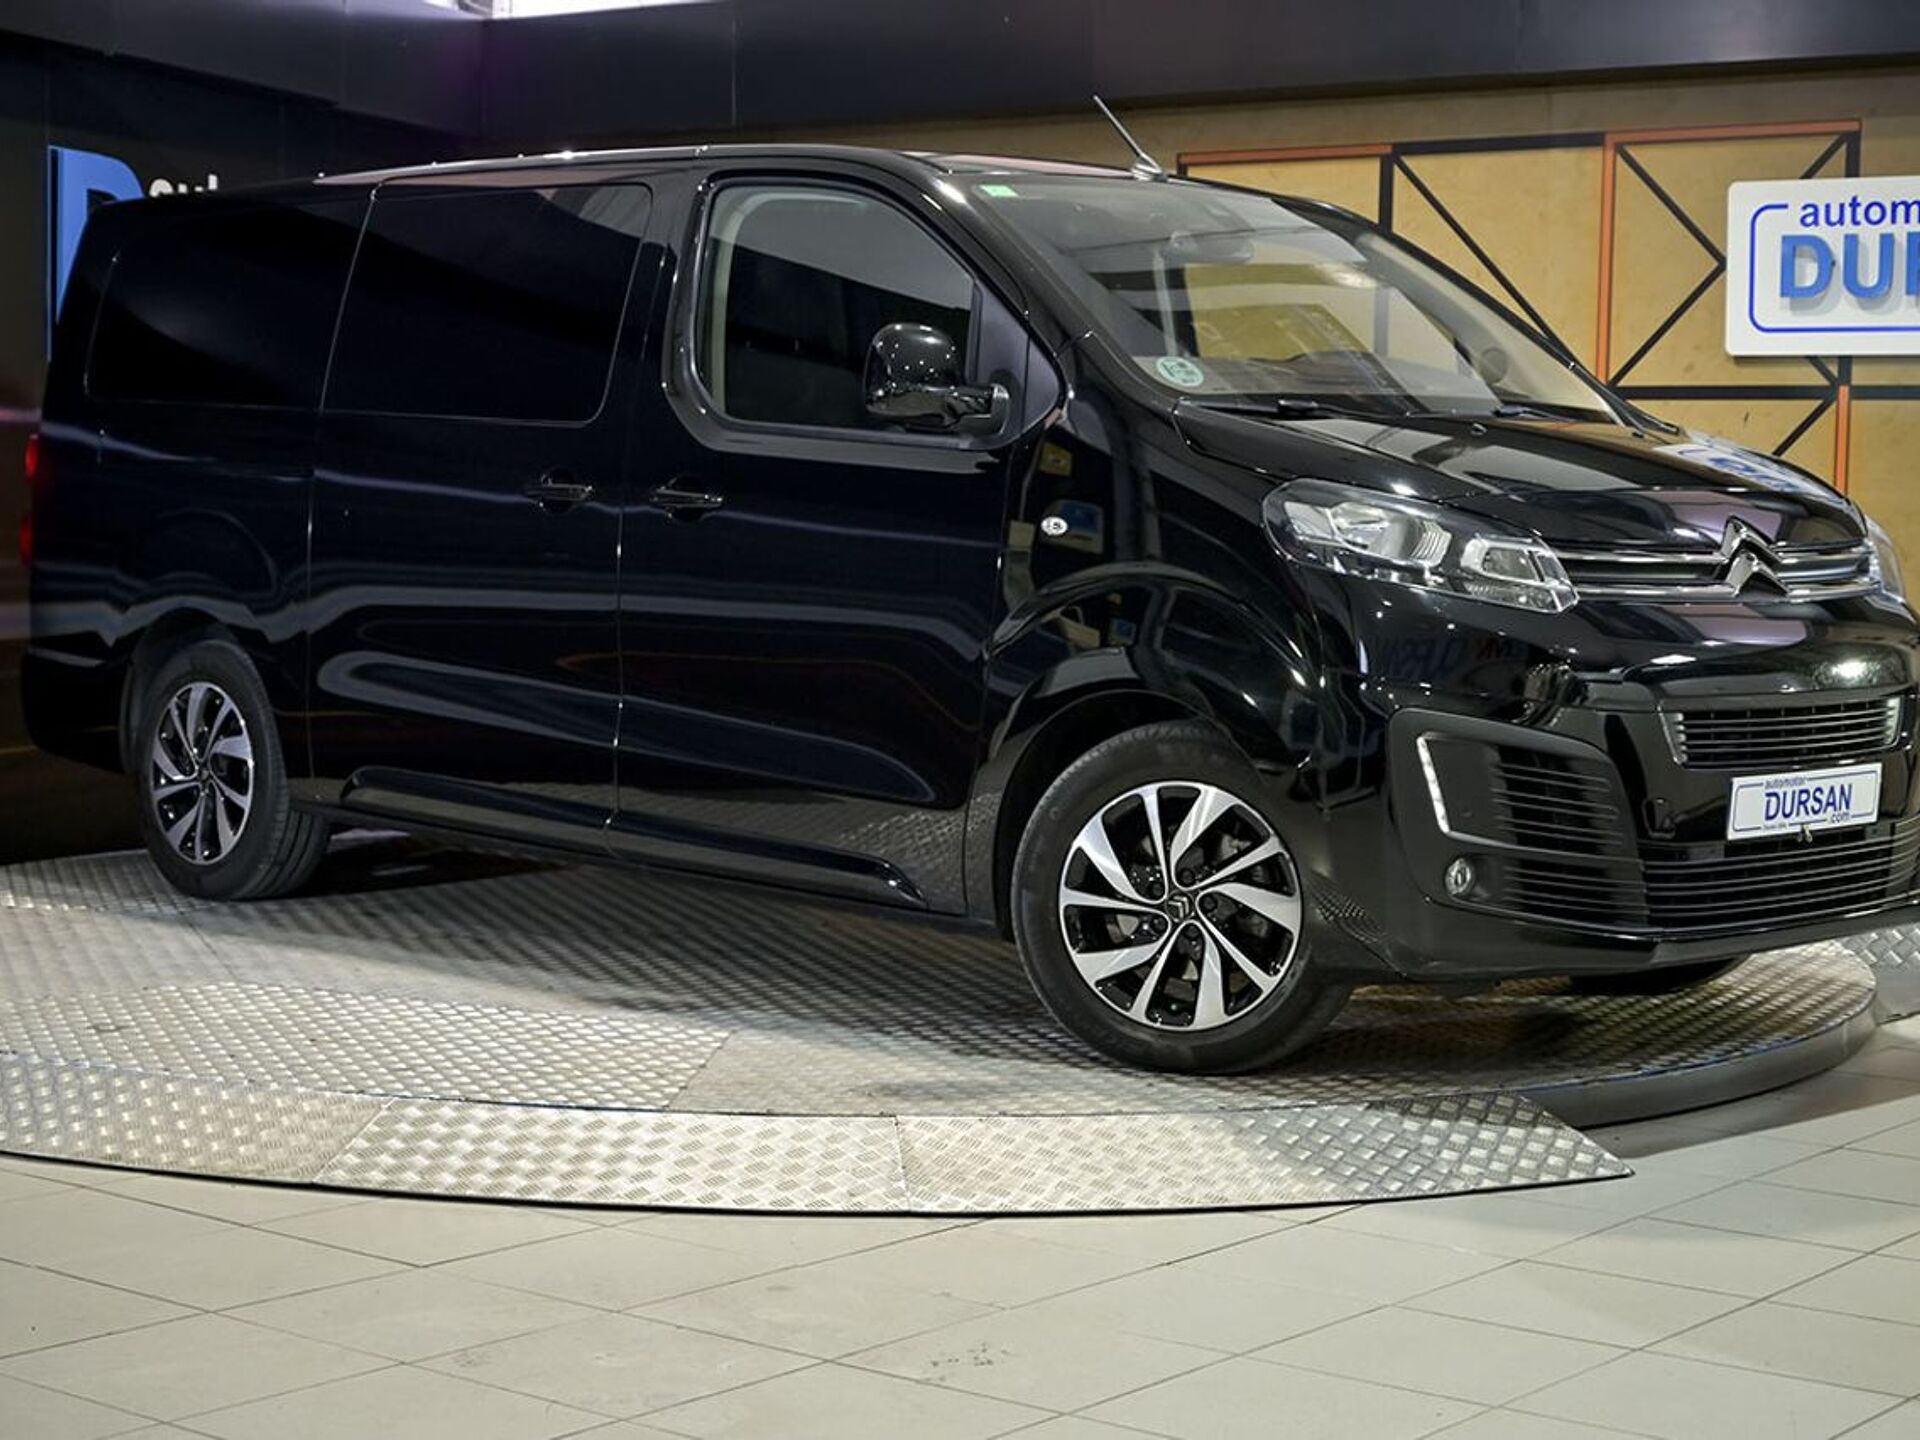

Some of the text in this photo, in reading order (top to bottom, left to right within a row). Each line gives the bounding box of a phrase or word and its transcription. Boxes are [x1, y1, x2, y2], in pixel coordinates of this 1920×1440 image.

[1799, 195, 1920, 227] autom
[1779, 231, 1920, 299] DU
[1764, 784, 1853, 821] DURSAN
